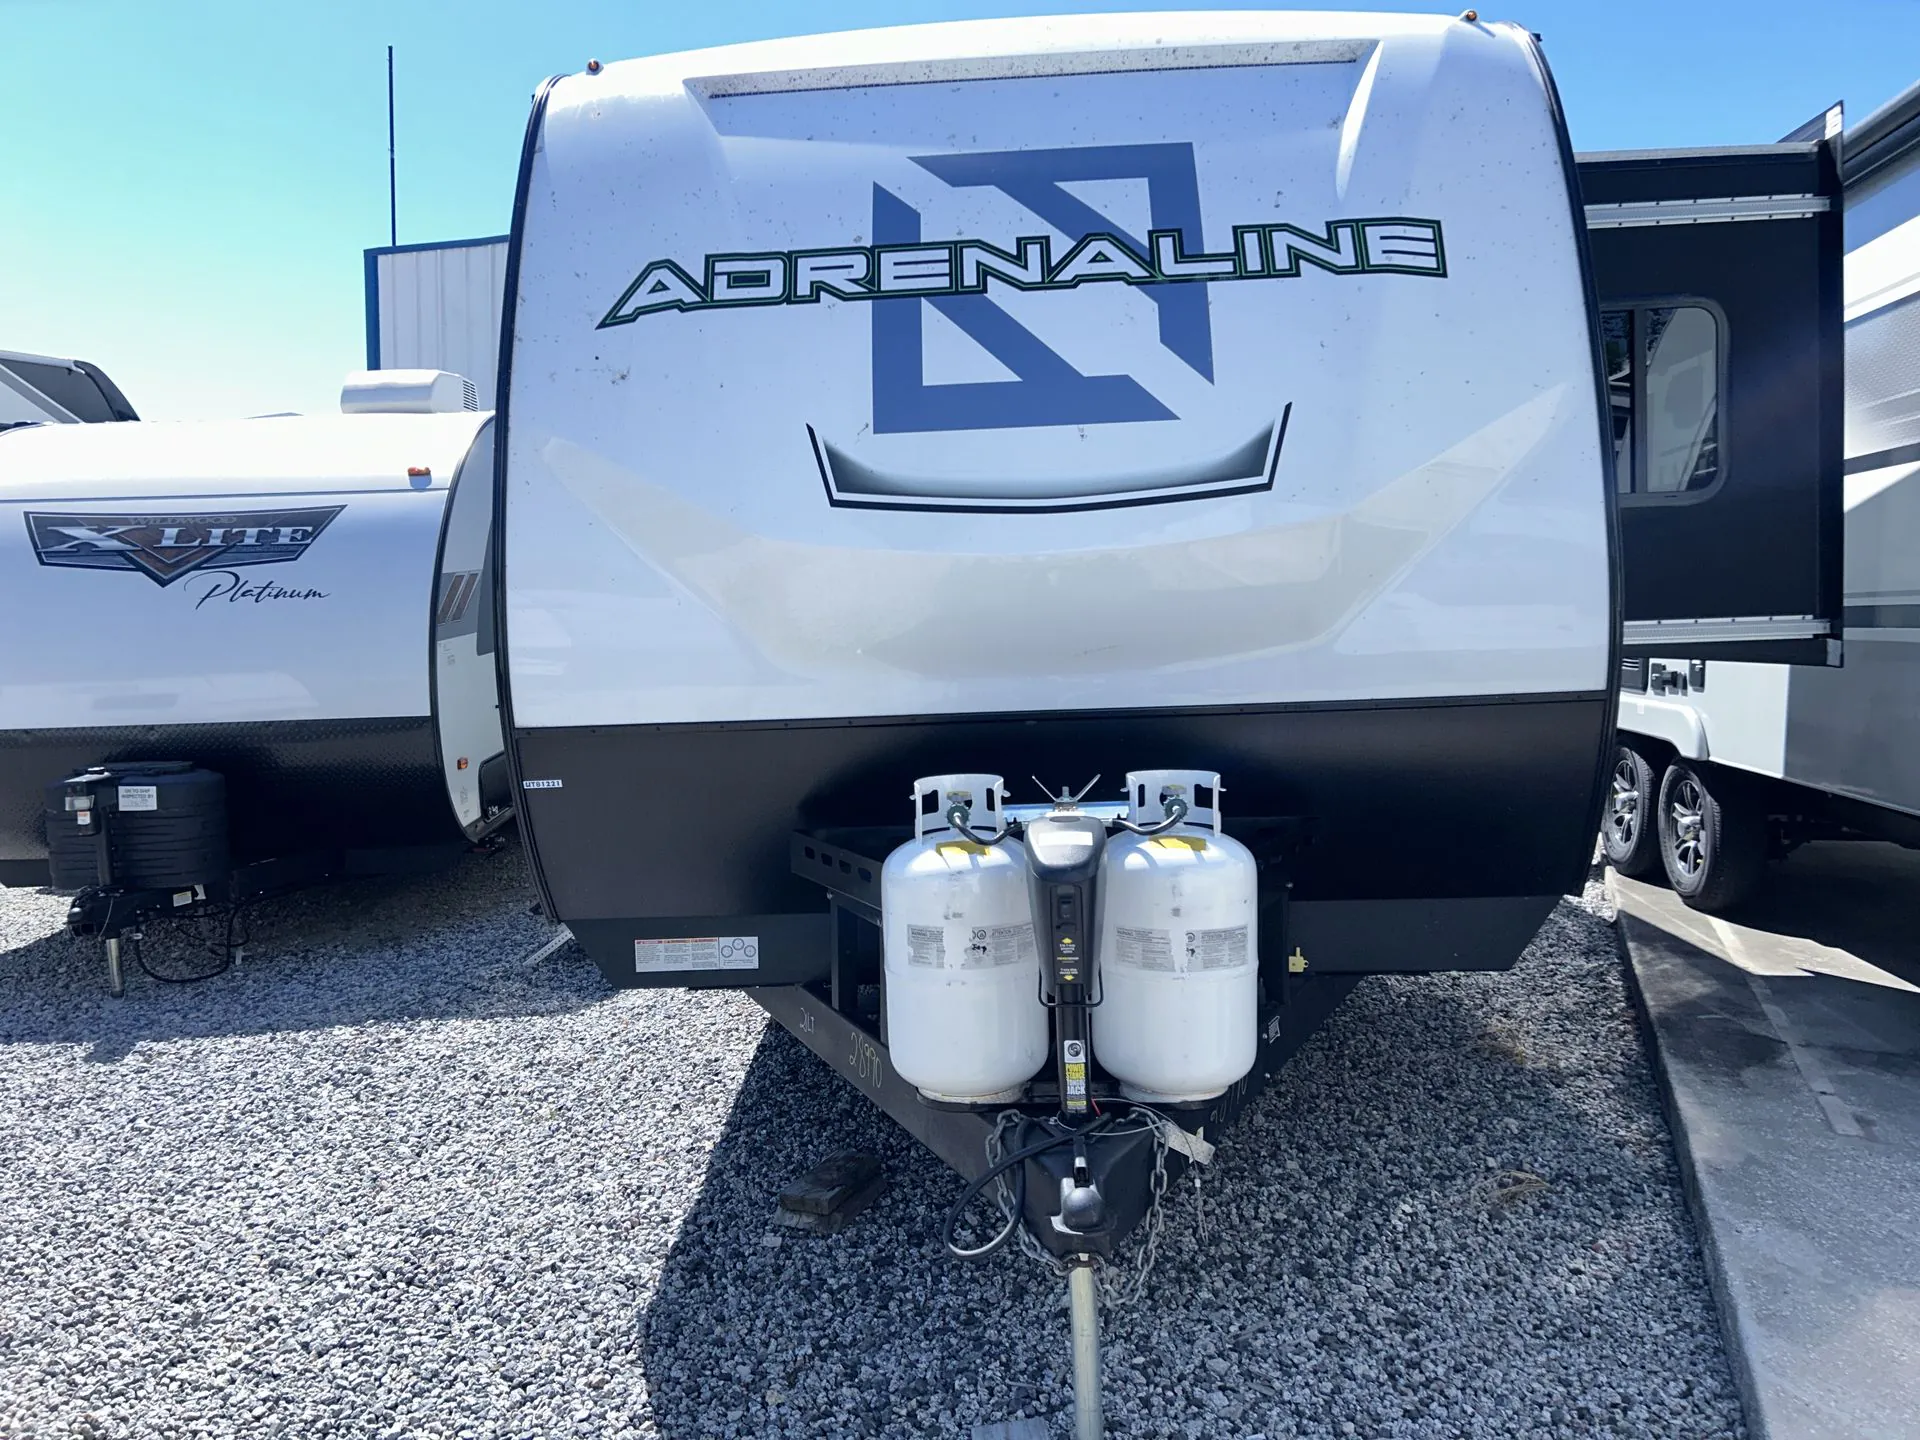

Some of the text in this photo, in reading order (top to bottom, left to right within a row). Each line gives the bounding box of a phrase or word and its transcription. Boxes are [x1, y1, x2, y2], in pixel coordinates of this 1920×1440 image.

[596, 218, 1448, 329] ADRENALINE
[38, 525, 315, 552] X LITE
[184, 570, 332, 610] Platinum
[849, 1031, 883, 1089] 28990
[1067, 1085, 1086, 1095] JACK
